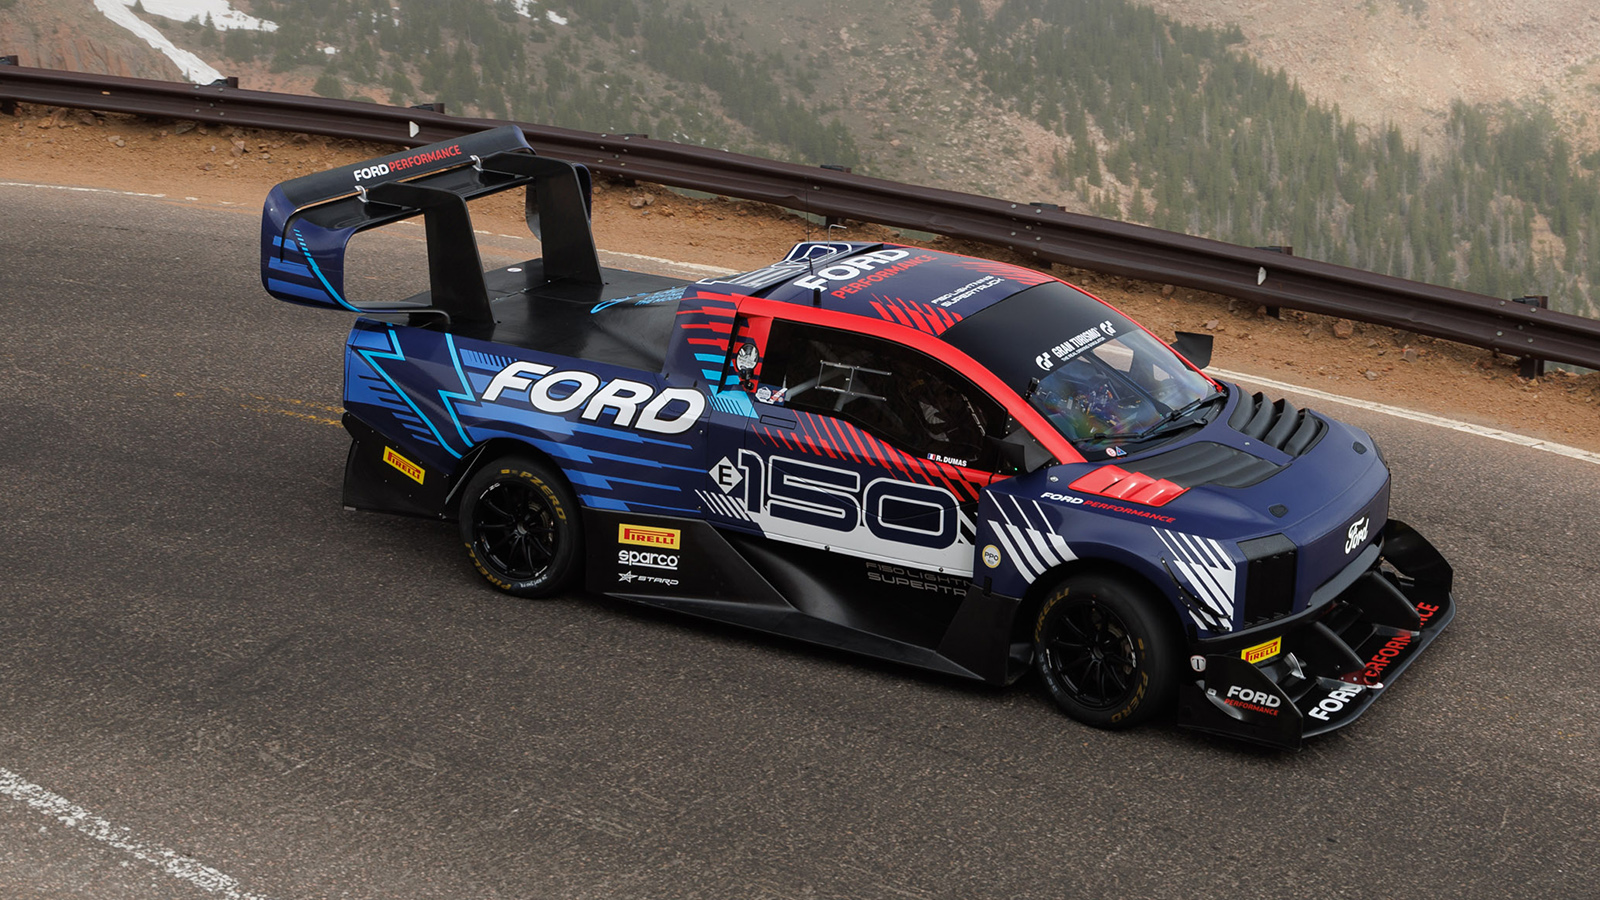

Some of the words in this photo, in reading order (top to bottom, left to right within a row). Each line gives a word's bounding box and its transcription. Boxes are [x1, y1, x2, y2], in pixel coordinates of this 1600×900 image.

[353, 164, 389, 181] FORD
[388, 144, 462, 172] PERFORMANCE
[793, 249, 910, 292] FORD
[831, 254, 938, 299] PERFORMANCE
[1051, 341, 1076, 358] GRAN
[1068, 327, 1101, 348] TURISMO
[481, 361, 706, 434] FORD
[386, 451, 422, 480] PIRELLI
[936, 454, 943, 462] R.
[943, 456, 968, 467] DUMAS
[718, 463, 733, 487] E
[738, 448, 961, 550] 150
[1040, 492, 1084, 504] FORD
[1083, 500, 1176, 523] PERFORMANCE
[623, 528, 676, 545] PIRELLI
[1344, 516, 1370, 555] Ford
[618, 549, 679, 569] sparco
[865, 561, 905, 575] F150
[984, 551, 999, 562] PPO
[637, 575, 680, 587] STARD
[867, 571, 968, 598] SUPERTR
[1245, 640, 1279, 662] PIRELLI
[1224, 698, 1279, 716] PERFORMANCE
[1227, 685, 1281, 708] FORD
